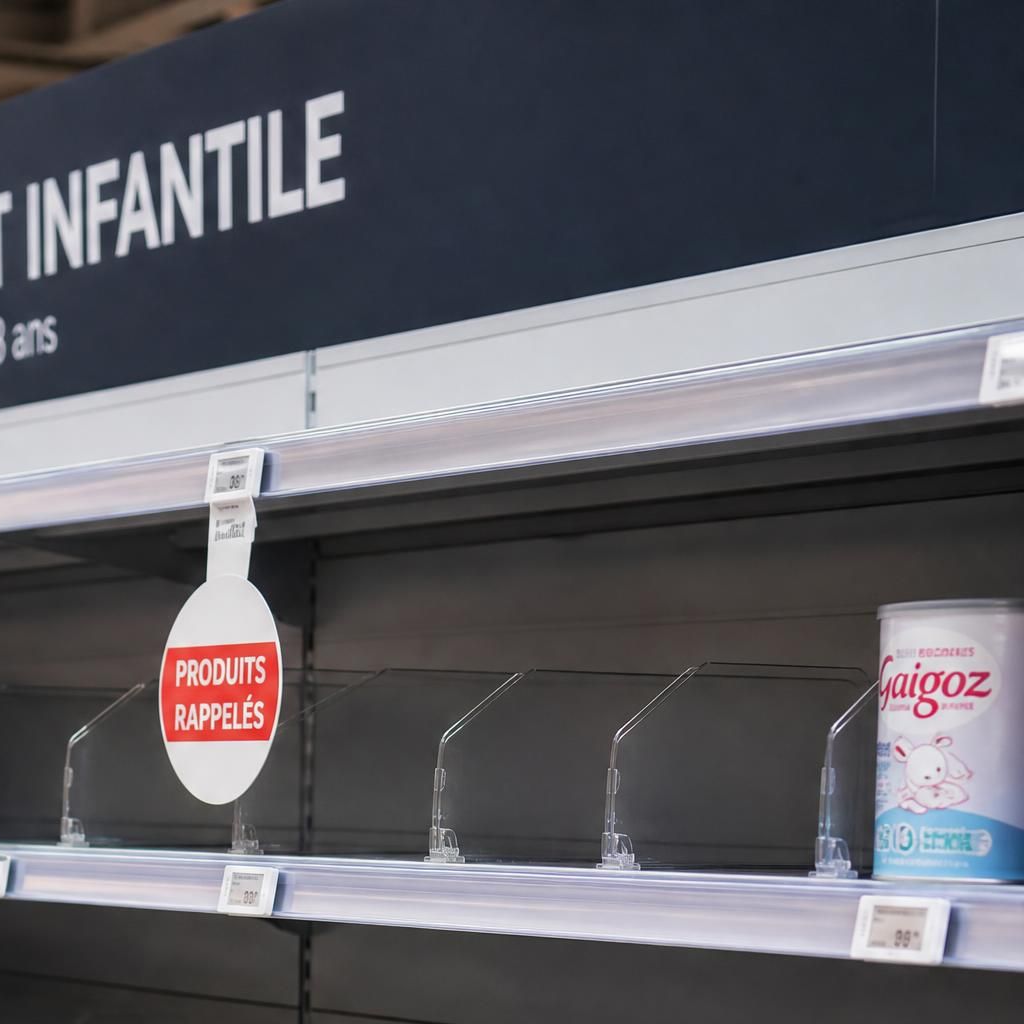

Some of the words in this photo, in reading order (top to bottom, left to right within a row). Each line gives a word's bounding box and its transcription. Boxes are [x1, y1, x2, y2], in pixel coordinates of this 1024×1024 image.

[27, 90, 346, 280] INFANTILE
[11, 315, 58, 361] ans
[176, 656, 266, 687] PRODUITS
[175, 694, 264, 731] RAPPELÉS
